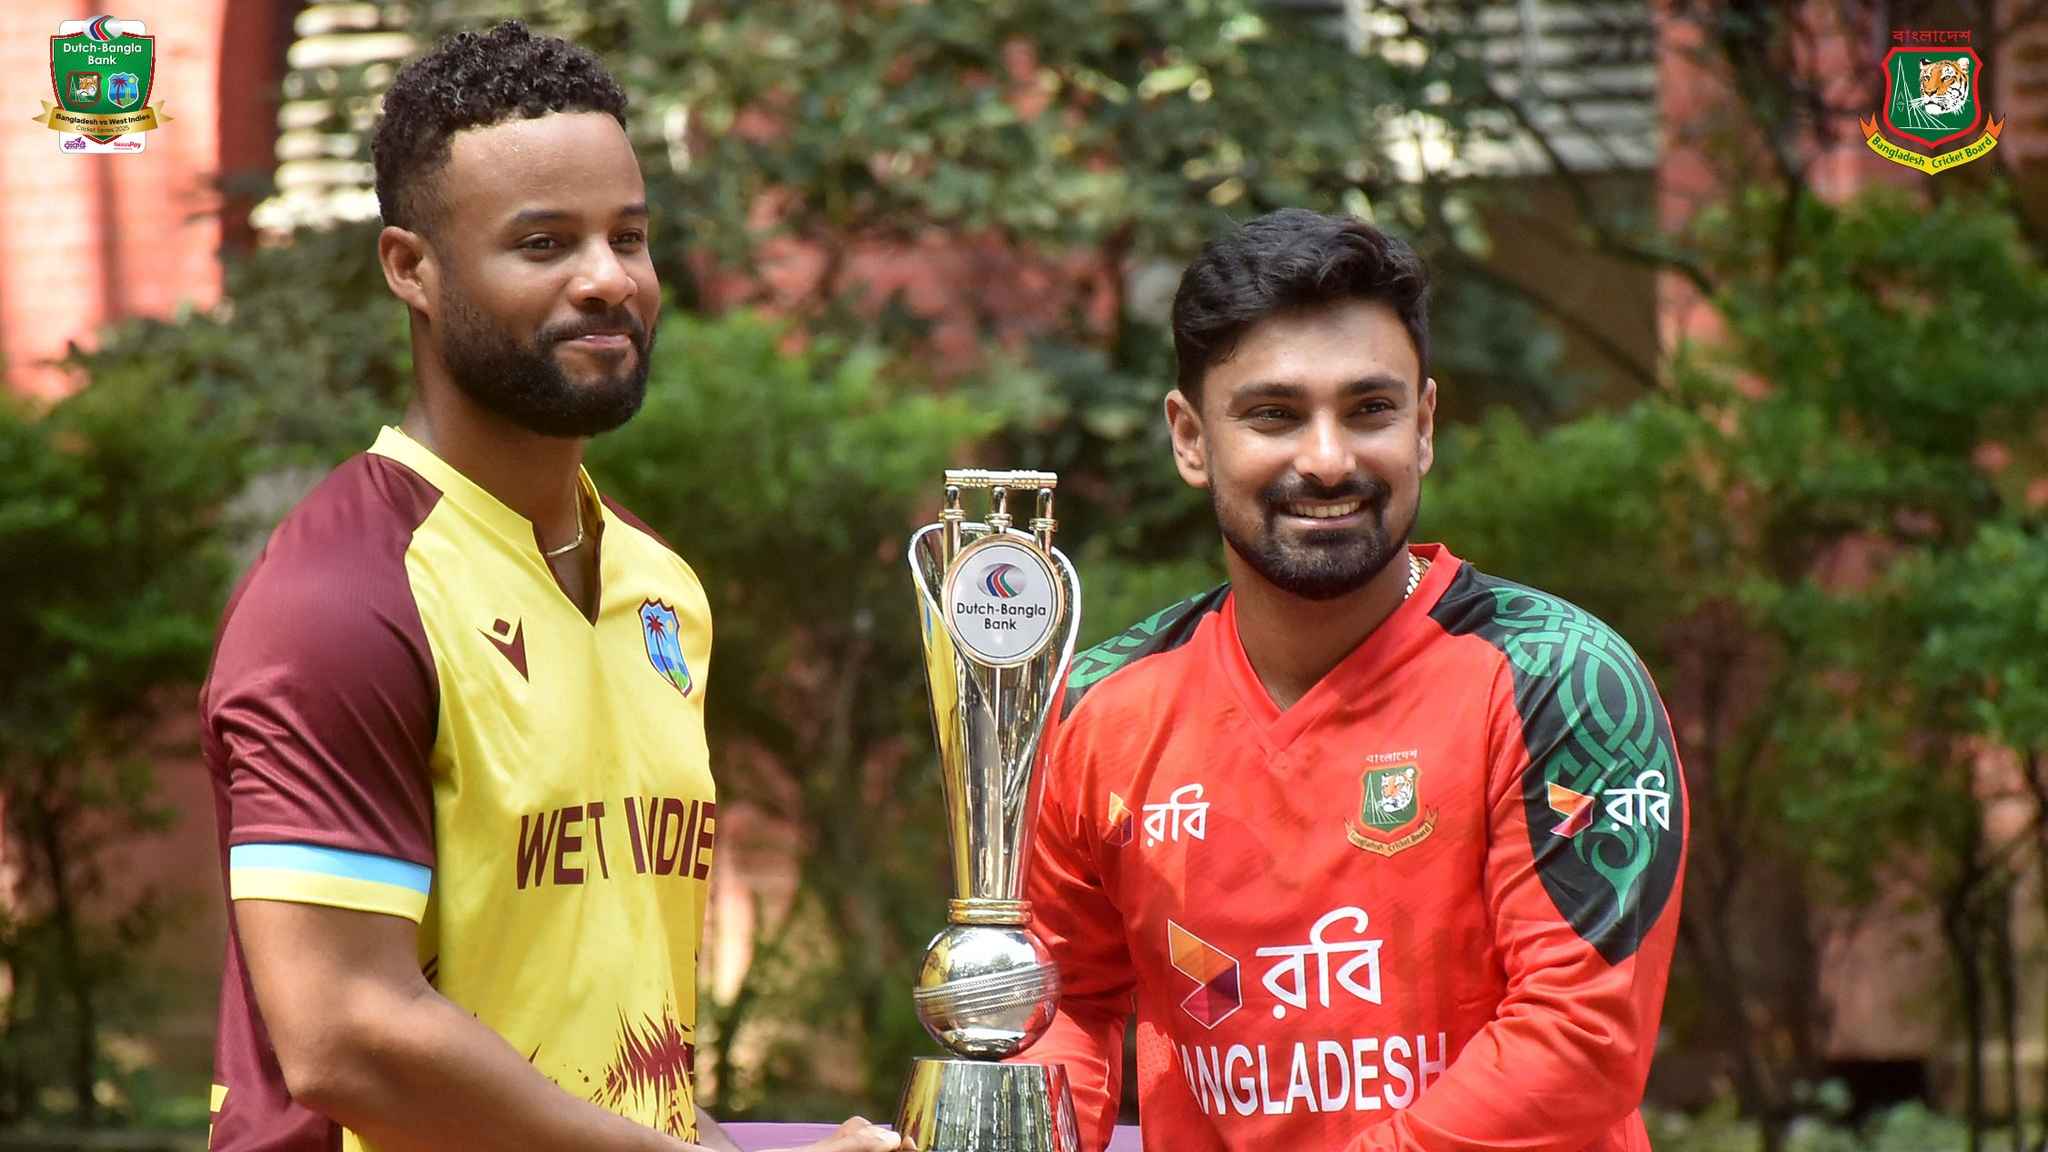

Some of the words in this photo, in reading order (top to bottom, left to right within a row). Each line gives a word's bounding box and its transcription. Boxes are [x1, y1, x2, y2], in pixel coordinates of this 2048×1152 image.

[956, 602, 1047, 618] Dutch-Bangla
[984, 618, 1017, 630] Bank
[1142, 783, 1210, 847] রবি
[1603, 769, 1671, 832] রবি
[516, 801, 609, 890] WET
[623, 796, 716, 881] IDIE
[1255, 906, 1383, 1020] রবি
[1181, 1031, 1447, 1117] ANGLADESH
